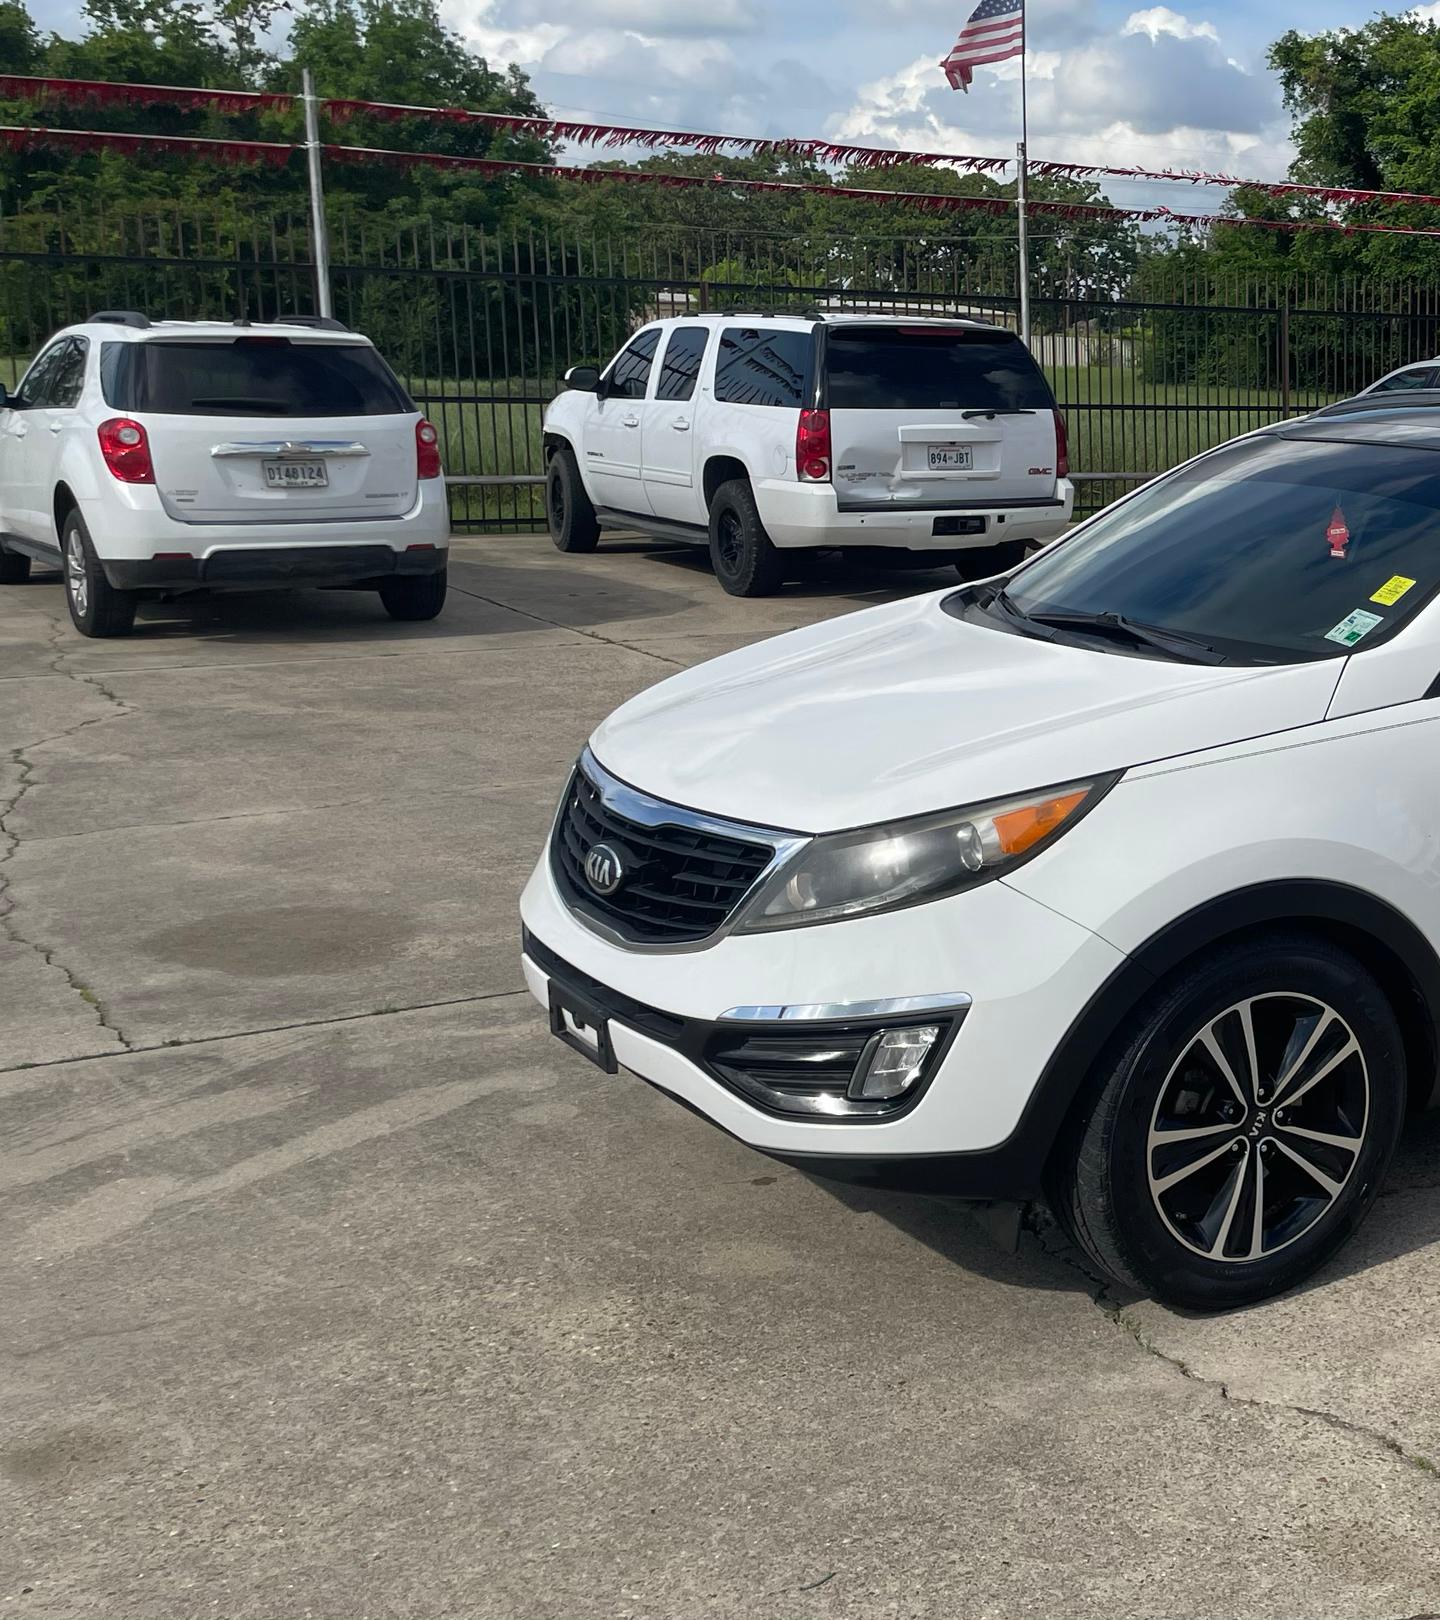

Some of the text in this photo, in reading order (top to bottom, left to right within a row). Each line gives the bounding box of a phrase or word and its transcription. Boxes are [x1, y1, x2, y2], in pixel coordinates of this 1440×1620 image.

[931, 452, 969, 464] 894 JBT
[587, 852, 610, 886] KIA
[1249, 1112, 1266, 1135] KIA
